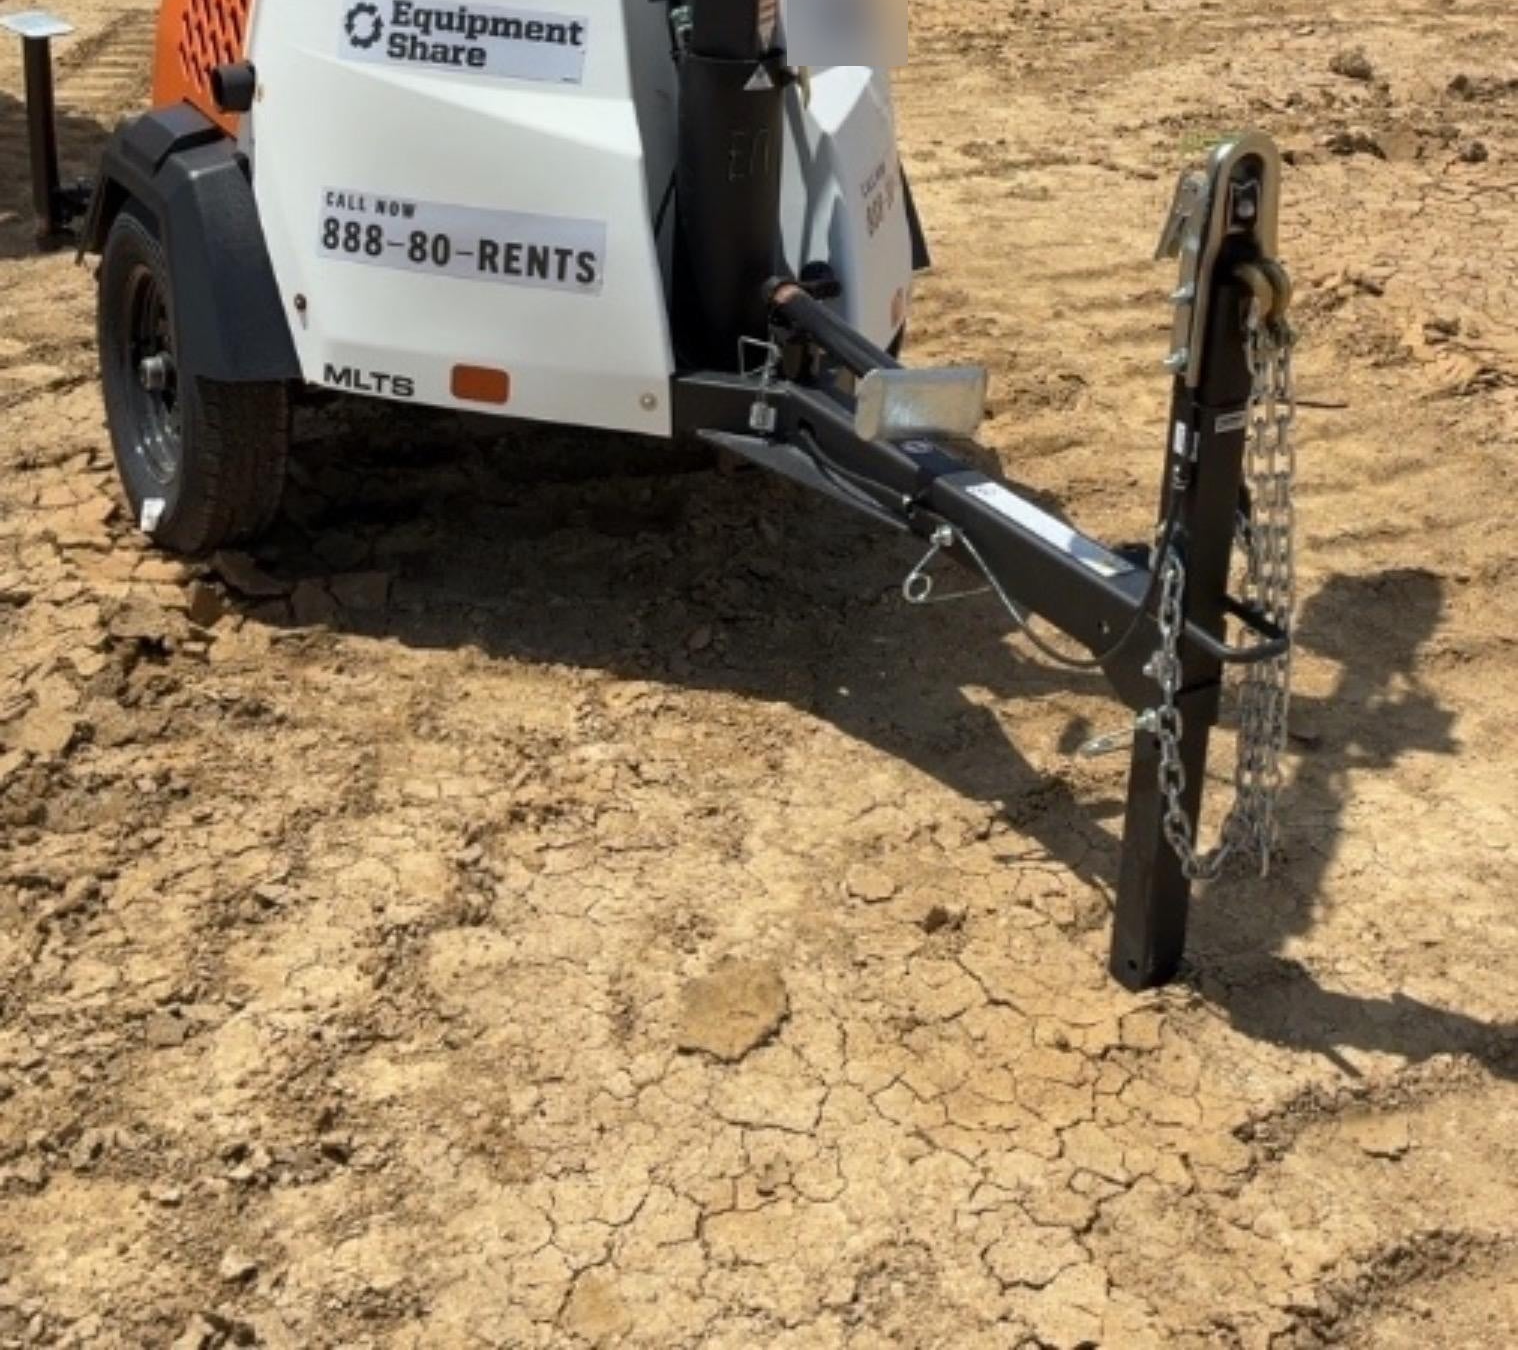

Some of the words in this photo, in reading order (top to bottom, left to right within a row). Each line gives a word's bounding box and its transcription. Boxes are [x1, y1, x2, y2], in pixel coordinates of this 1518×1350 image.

[389, 0, 584, 47] Equipment
[386, 33, 487, 67] Share
[325, 191, 367, 212] CALL
[374, 199, 416, 219] NOW
[322, 216, 598, 285] 888-80-RENTS
[323, 363, 415, 398] MLTS
